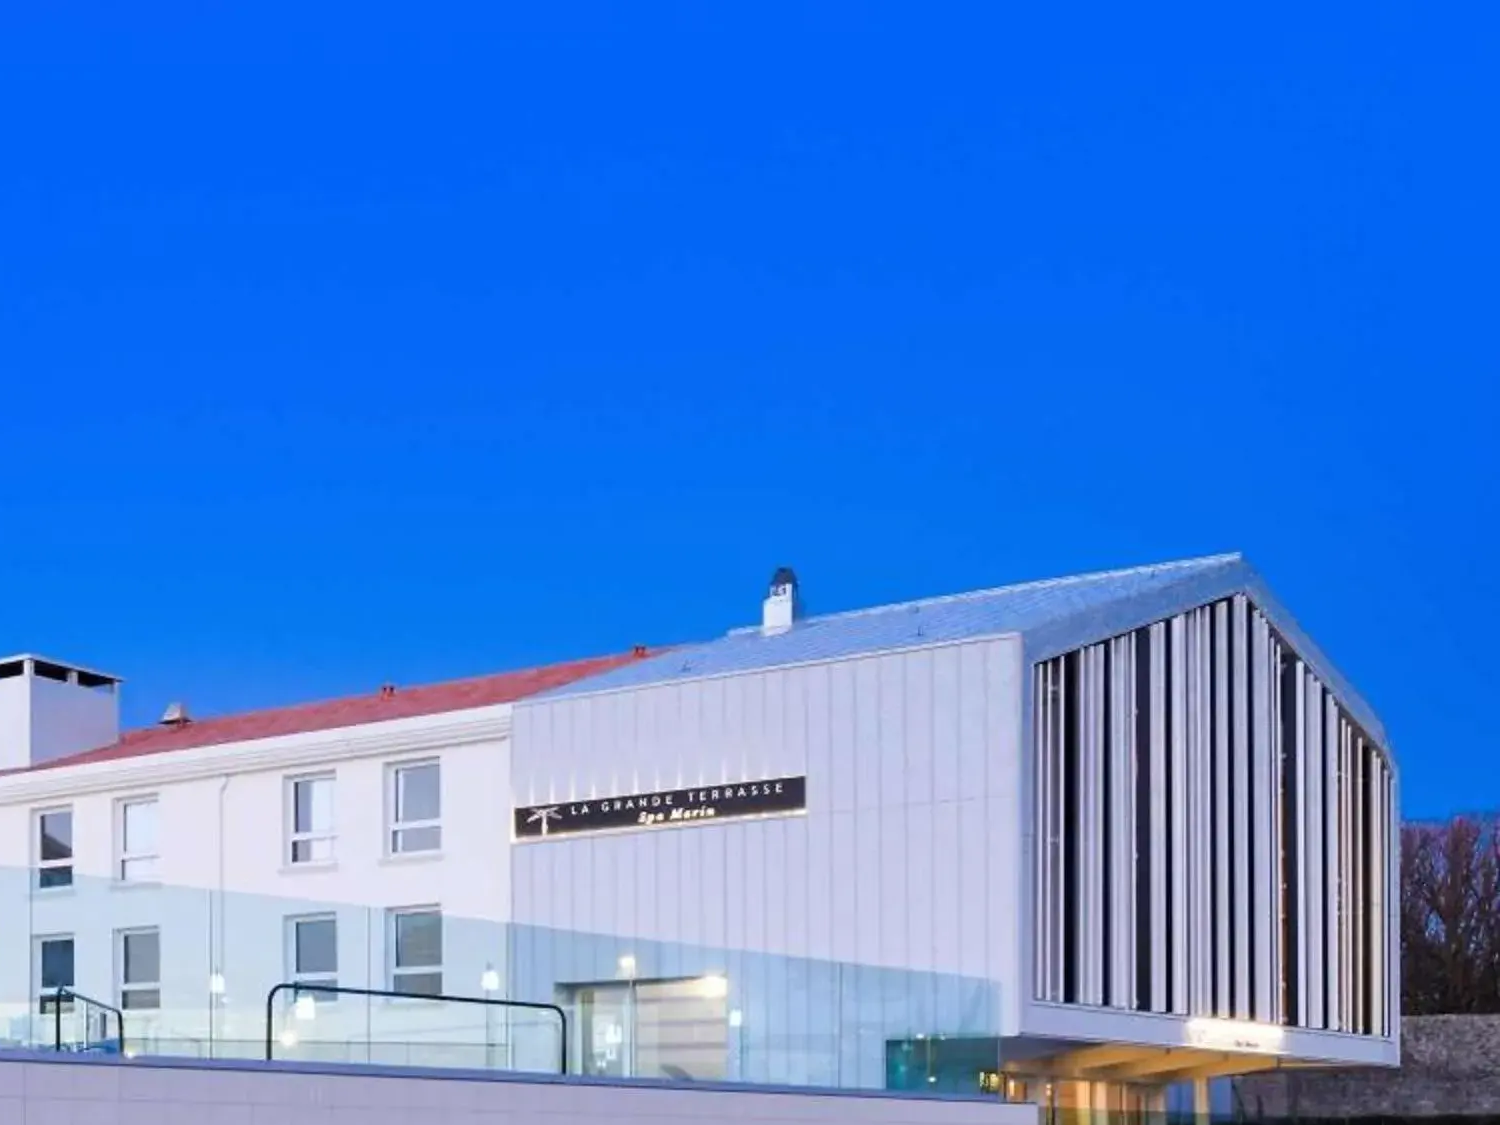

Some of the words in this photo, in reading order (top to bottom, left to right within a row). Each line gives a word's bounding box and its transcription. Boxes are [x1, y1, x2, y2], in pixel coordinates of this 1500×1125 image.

[570, 804, 589, 815] LA
[601, 795, 673, 812] GRANDE
[688, 782, 784, 803] TERRASSE
[638, 811, 665, 825] Spa
[669, 804, 716, 821] Marin
